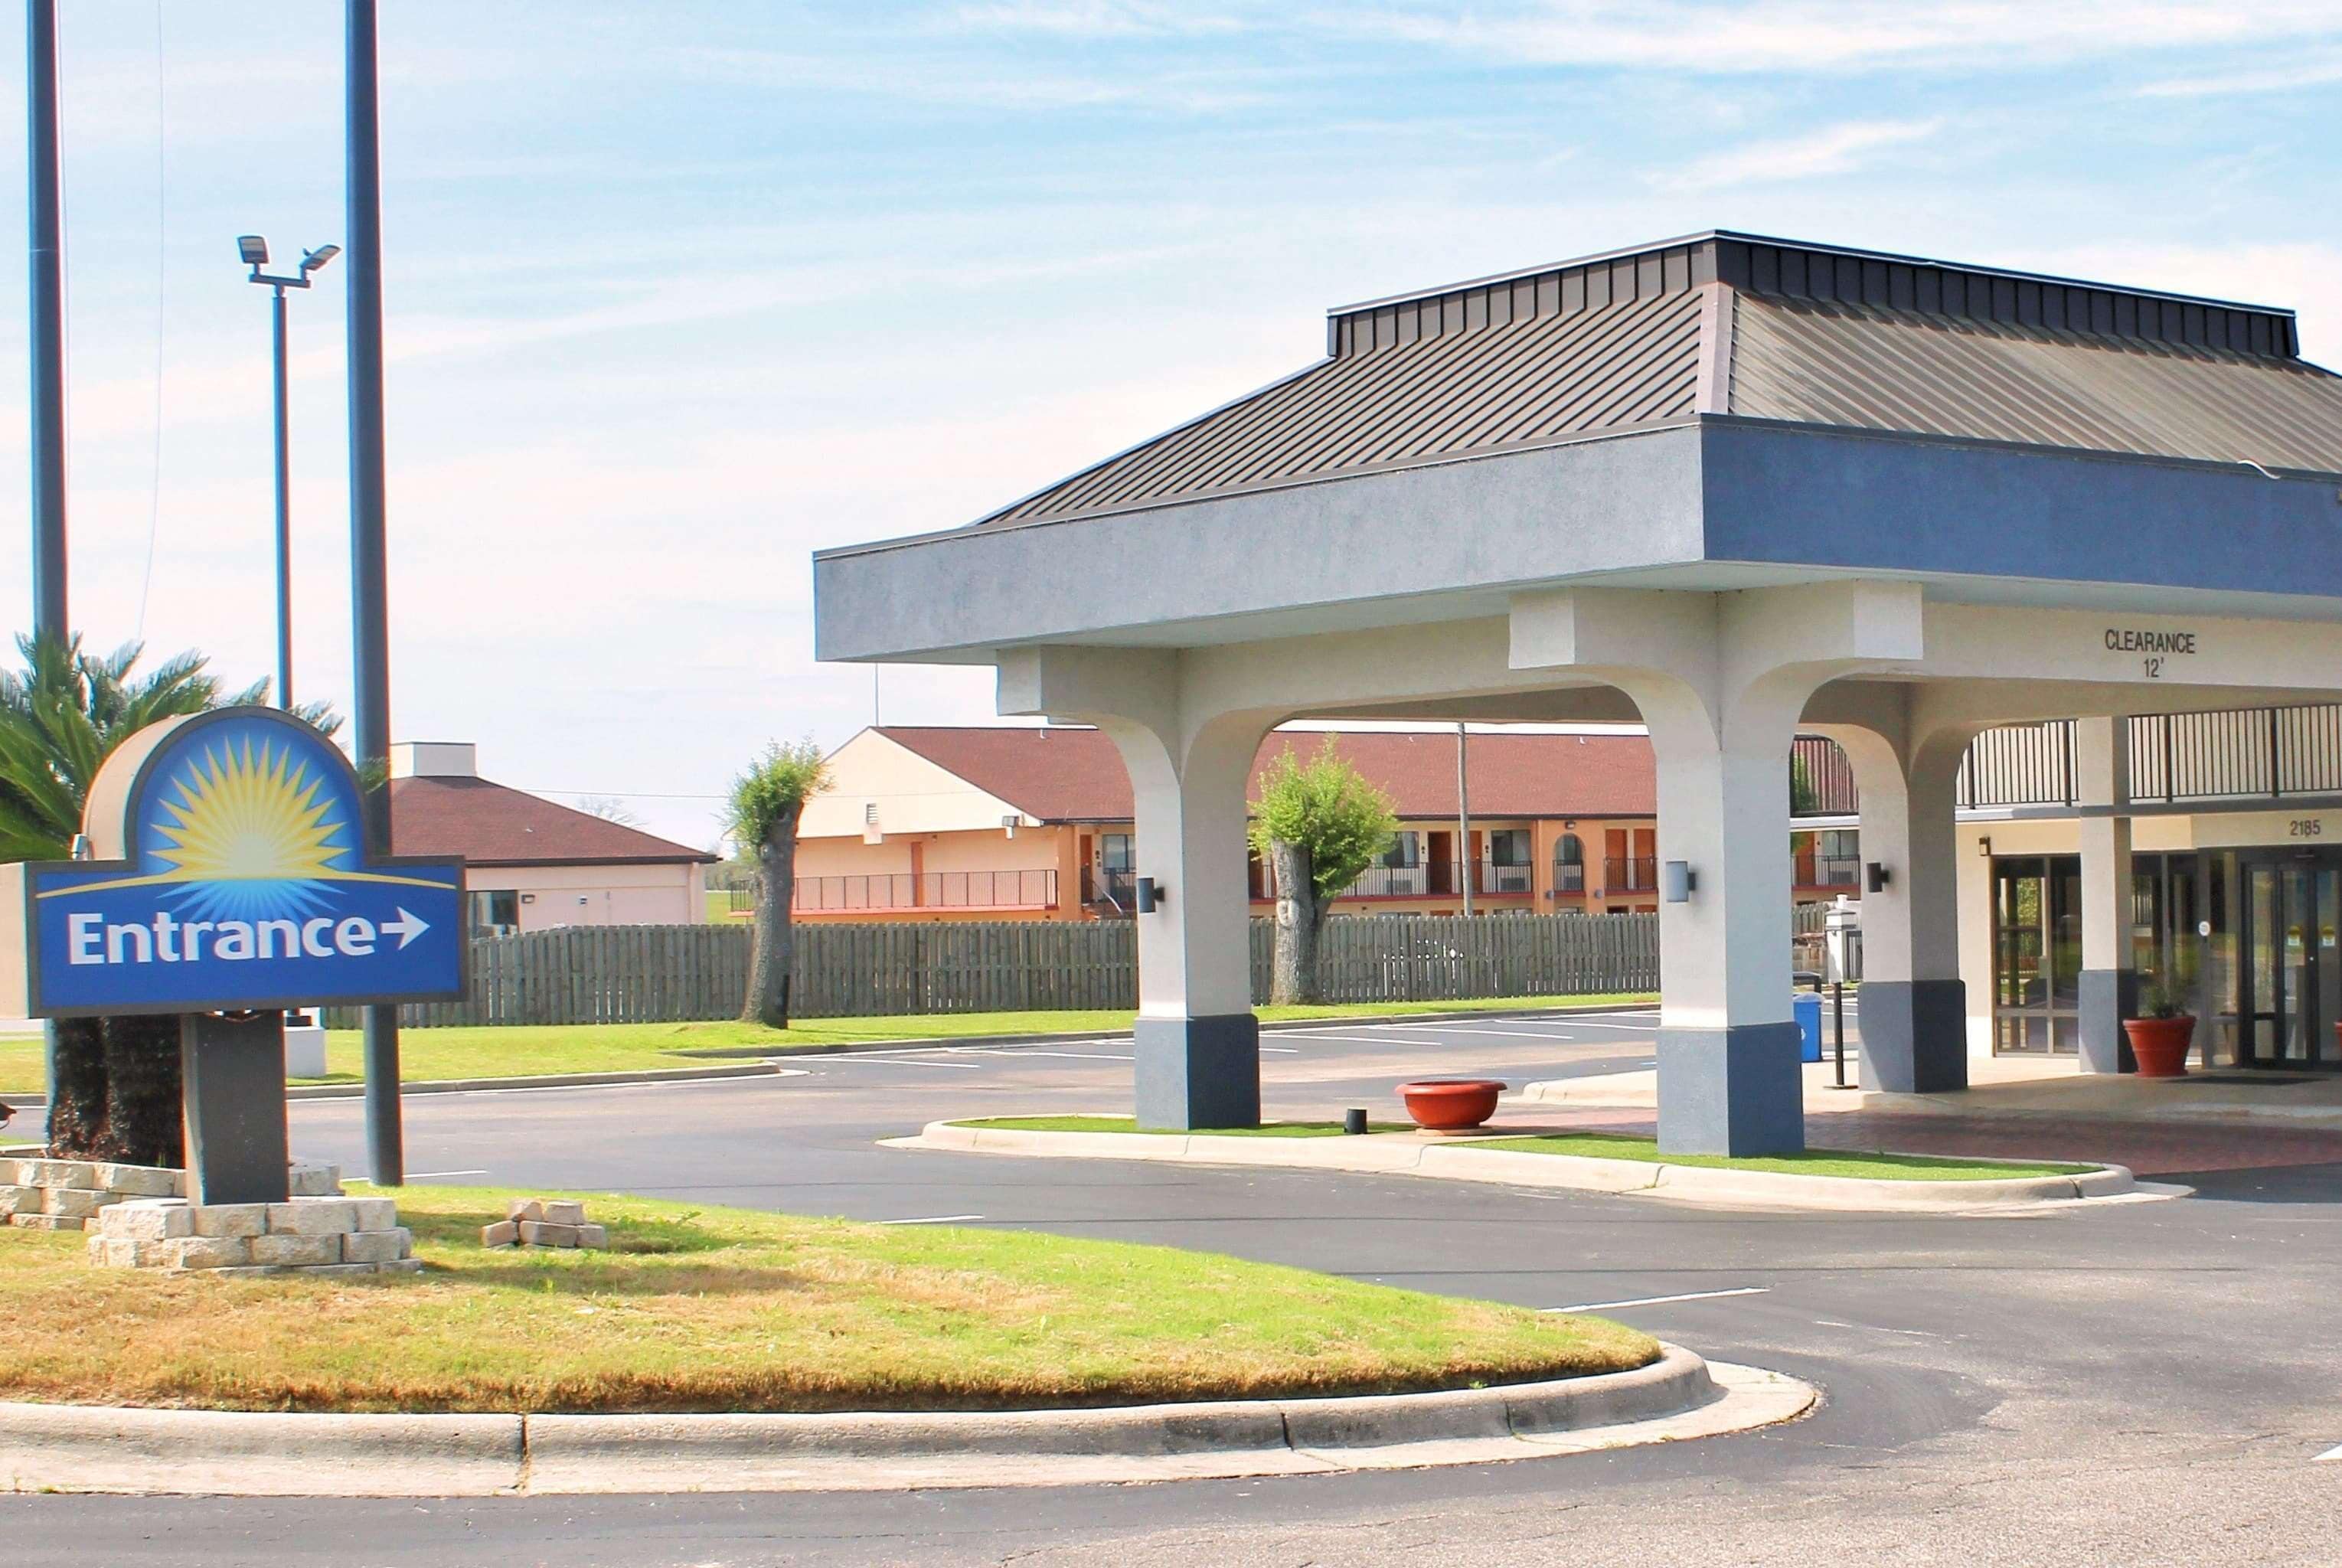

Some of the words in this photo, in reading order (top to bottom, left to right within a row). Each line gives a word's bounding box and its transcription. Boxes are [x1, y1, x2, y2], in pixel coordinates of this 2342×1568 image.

[2105, 629, 2196, 654] CLEARANCE
[2143, 657, 2164, 678] 12'
[2289, 819, 2321, 837] 2185
[67, 911, 376, 965] Entrance
